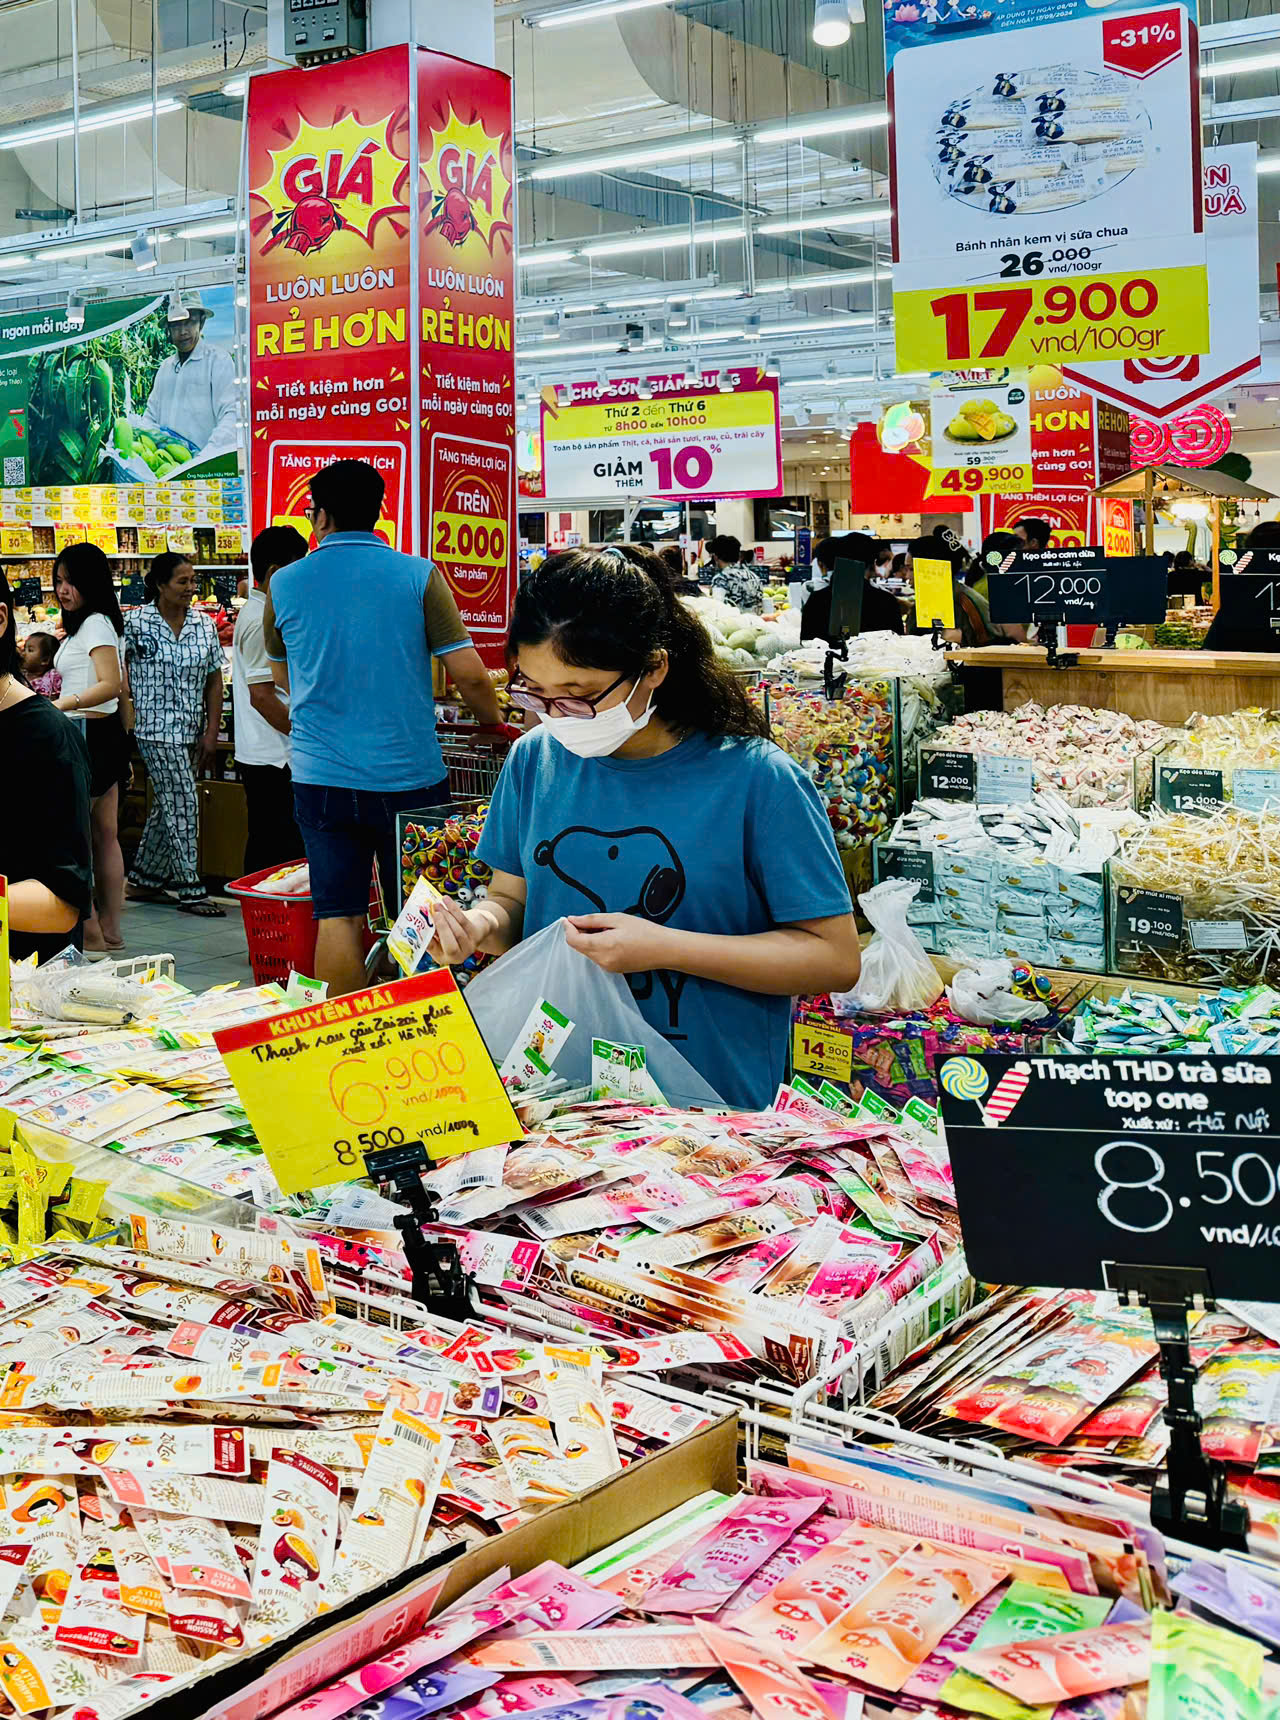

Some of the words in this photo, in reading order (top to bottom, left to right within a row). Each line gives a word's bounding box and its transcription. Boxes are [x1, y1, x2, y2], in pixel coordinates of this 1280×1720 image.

[1111, 24, 1176, 47] -31%
[280, 137, 381, 206] GIÁ
[437, 143, 496, 216] GIÁ
[956, 240, 988, 253] Bánh
[990, 237, 1021, 250] nhân
[1024, 233, 1052, 246] kem
[1055, 232, 1067, 245] vị
[1070, 229, 1093, 242] sữa
[1096, 226, 1129, 240] chua
[1000, 247, 1092, 279] 26.000
[1048, 260, 1102, 275] vnd/100gr
[266, 274, 325, 303] LUÔN
[331, 265, 395, 294] LUÔN
[427, 266, 466, 293] LUÔN
[468, 273, 505, 299] LUÔN
[3, 325, 31, 341] ngon
[32, 317, 54, 334] mỗi
[256, 305, 306, 357] RẺ
[313, 307, 407, 350] HƠN
[421, 296, 454, 345] RẺ
[457, 311, 511, 352] HƠN
[930, 278, 1159, 361] 17.900
[1030, 325, 1166, 355] vnd/100gr
[276, 380, 308, 399] Tiết
[309, 379, 350, 397] kiệm
[353, 376, 385, 392] hơn
[435, 373, 456, 390] Tiết
[457, 375, 481, 393] kiệm
[482, 380, 501, 394] hơn
[649, 374, 690, 393] GIẢM
[1035, 385, 1081, 402] LUÔN
[256, 402, 285, 422] mỗi
[288, 403, 327, 421] ngày
[331, 399, 371, 417] cùng
[375, 397, 408, 412] GO!
[422, 393, 442, 411] mỗi
[444, 398, 468, 414] ngày
[470, 399, 494, 417] cùng
[495, 402, 513, 417] GO!
[604, 405, 628, 419] Thứ
[631, 405, 640, 417] 2
[642, 402, 666, 416] đến
[668, 400, 695, 414] Thứ
[696, 399, 706, 411] 6
[615, 419, 648, 432] 8h00
[666, 414, 707, 427] 10h00
[280, 454, 312, 469] TĂNG
[438, 449, 460, 464] TĂNG
[461, 450, 482, 467] THÊM
[1052, 447, 1076, 458] hơn
[593, 456, 643, 478] GIẢM
[1037, 461, 1067, 473] cùng
[1069, 460, 1092, 471] GO!
[615, 476, 643, 488] THÊM
[940, 466, 1025, 493] 49.900
[455, 488, 490, 514] TRÊN
[435, 521, 505, 560] 2.000
[453, 565, 466, 580] Sản
[468, 564, 488, 581] phẩm
[1014, 573, 1102, 605] 12.000
[472, 608, 487, 623] cuối
[488, 612, 503, 624] năm
[931, 775, 969, 789] 12.000
[1127, 916, 1172, 934] 19.100
[268, 999, 353, 1037] KHUYẾN
[354, 989, 395, 1015] MÃI
[801, 1038, 849, 1059] 14.900
[1031, 1057, 1110, 1086] Thạch
[1114, 1059, 1173, 1084] THD
[1178, 1060, 1218, 1084] trà
[1222, 1061, 1272, 1086] sữa
[329, 1041, 467, 1127] 6.900
[1104, 1087, 1153, 1112] top
[1157, 1090, 1209, 1111] one
[1121, 1116, 1154, 1131] Xuất
[332, 1126, 405, 1167] 8.500
[1094, 1140, 1280, 1235] 8.50
